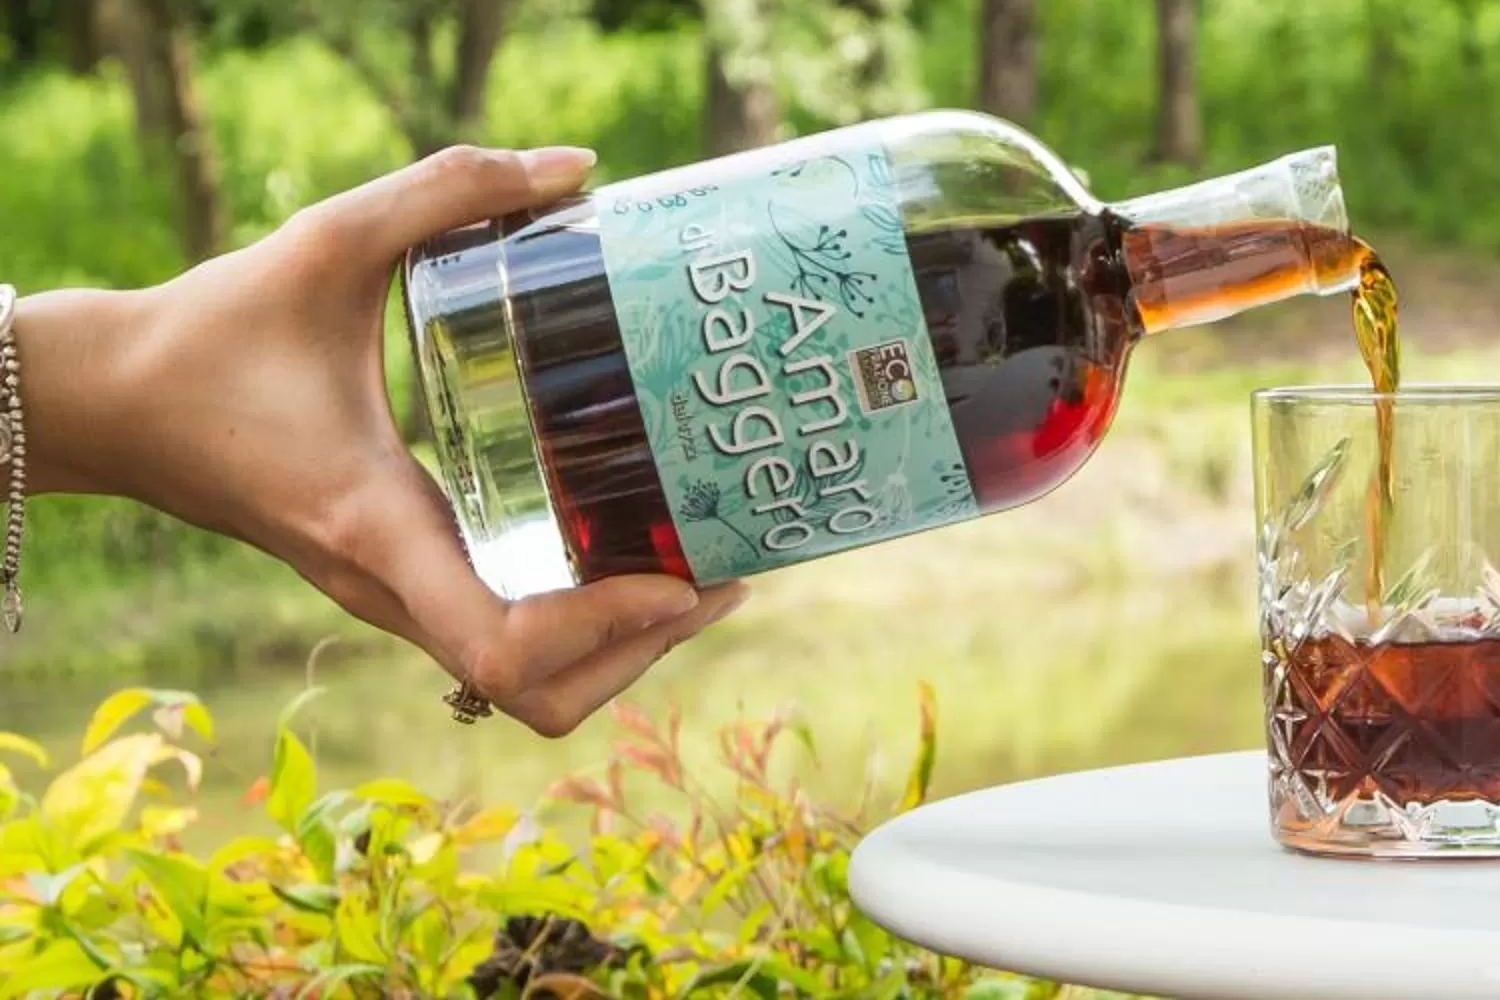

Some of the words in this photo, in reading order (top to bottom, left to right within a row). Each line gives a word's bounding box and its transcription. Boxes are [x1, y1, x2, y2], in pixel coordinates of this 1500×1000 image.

[678, 223, 718, 254] di
[688, 248, 813, 552] Baggero
[766, 290, 879, 536] Amaro
[880, 343, 914, 400] ECO
